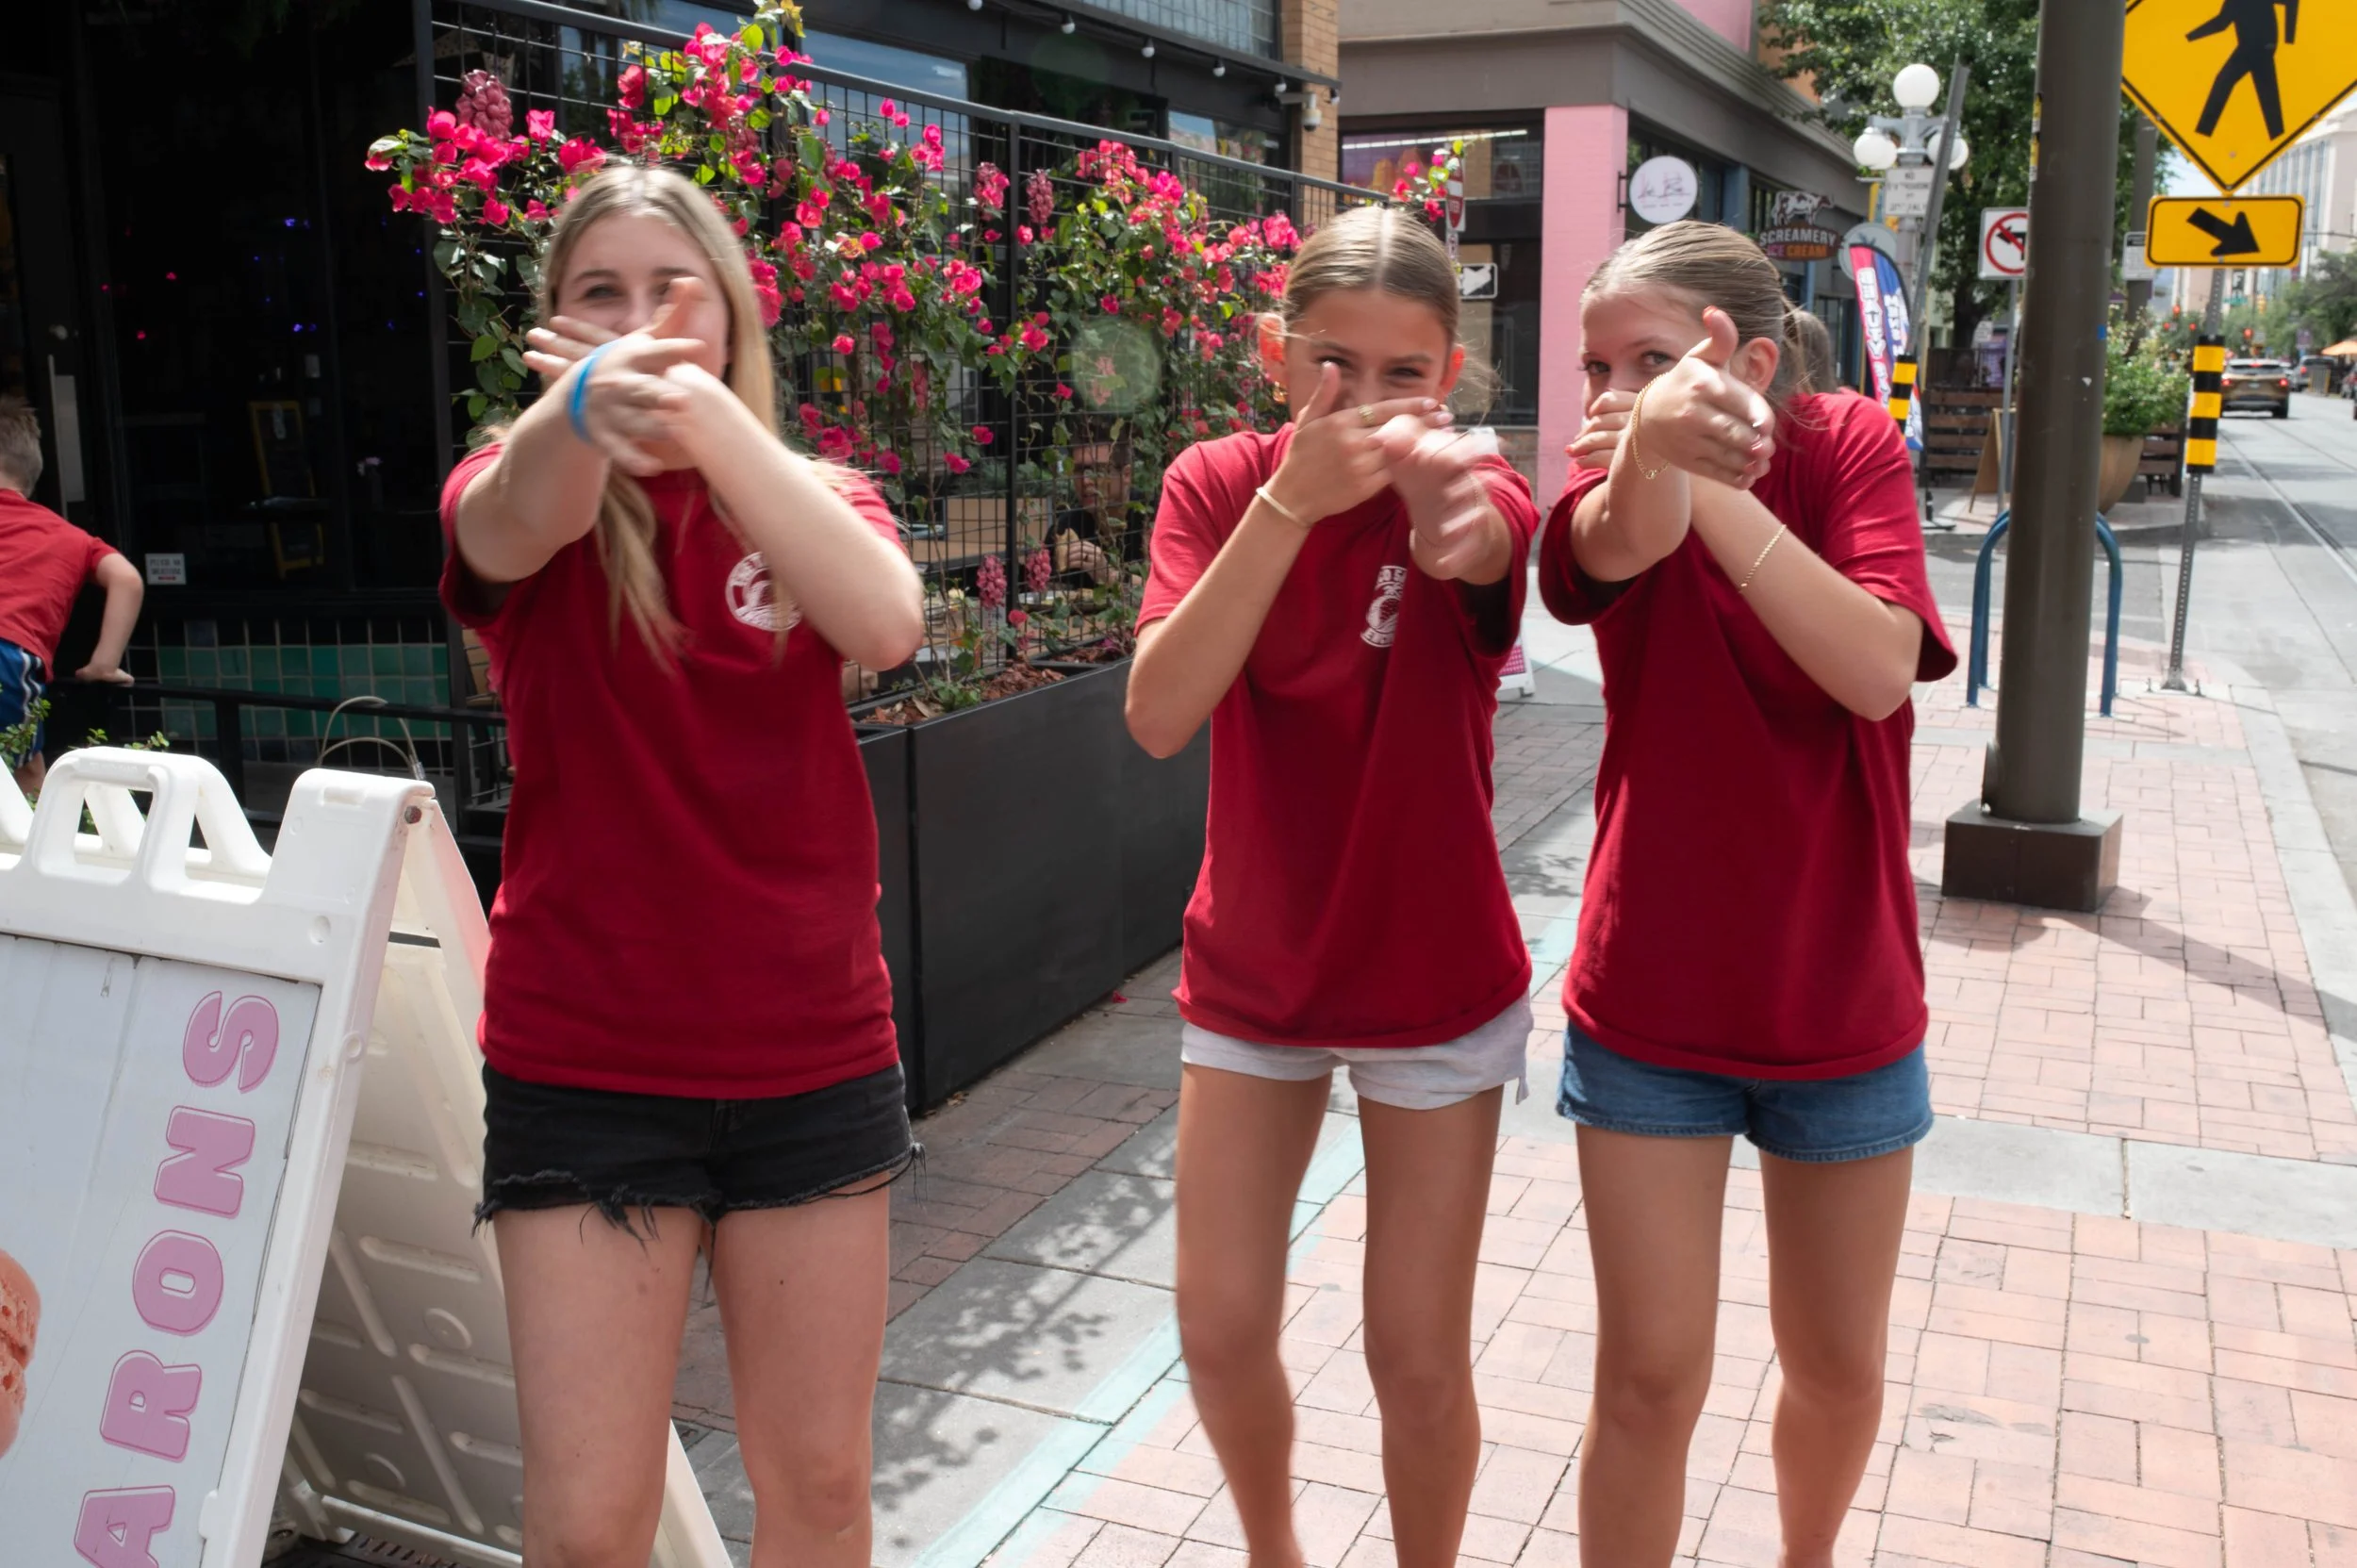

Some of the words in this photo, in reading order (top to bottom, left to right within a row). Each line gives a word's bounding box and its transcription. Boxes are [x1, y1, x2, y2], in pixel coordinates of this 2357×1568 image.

[1759, 227, 1837, 247] SCREAMERY
[1768, 244, 1785, 257] ICE
[1787, 244, 1826, 257] CREAM
